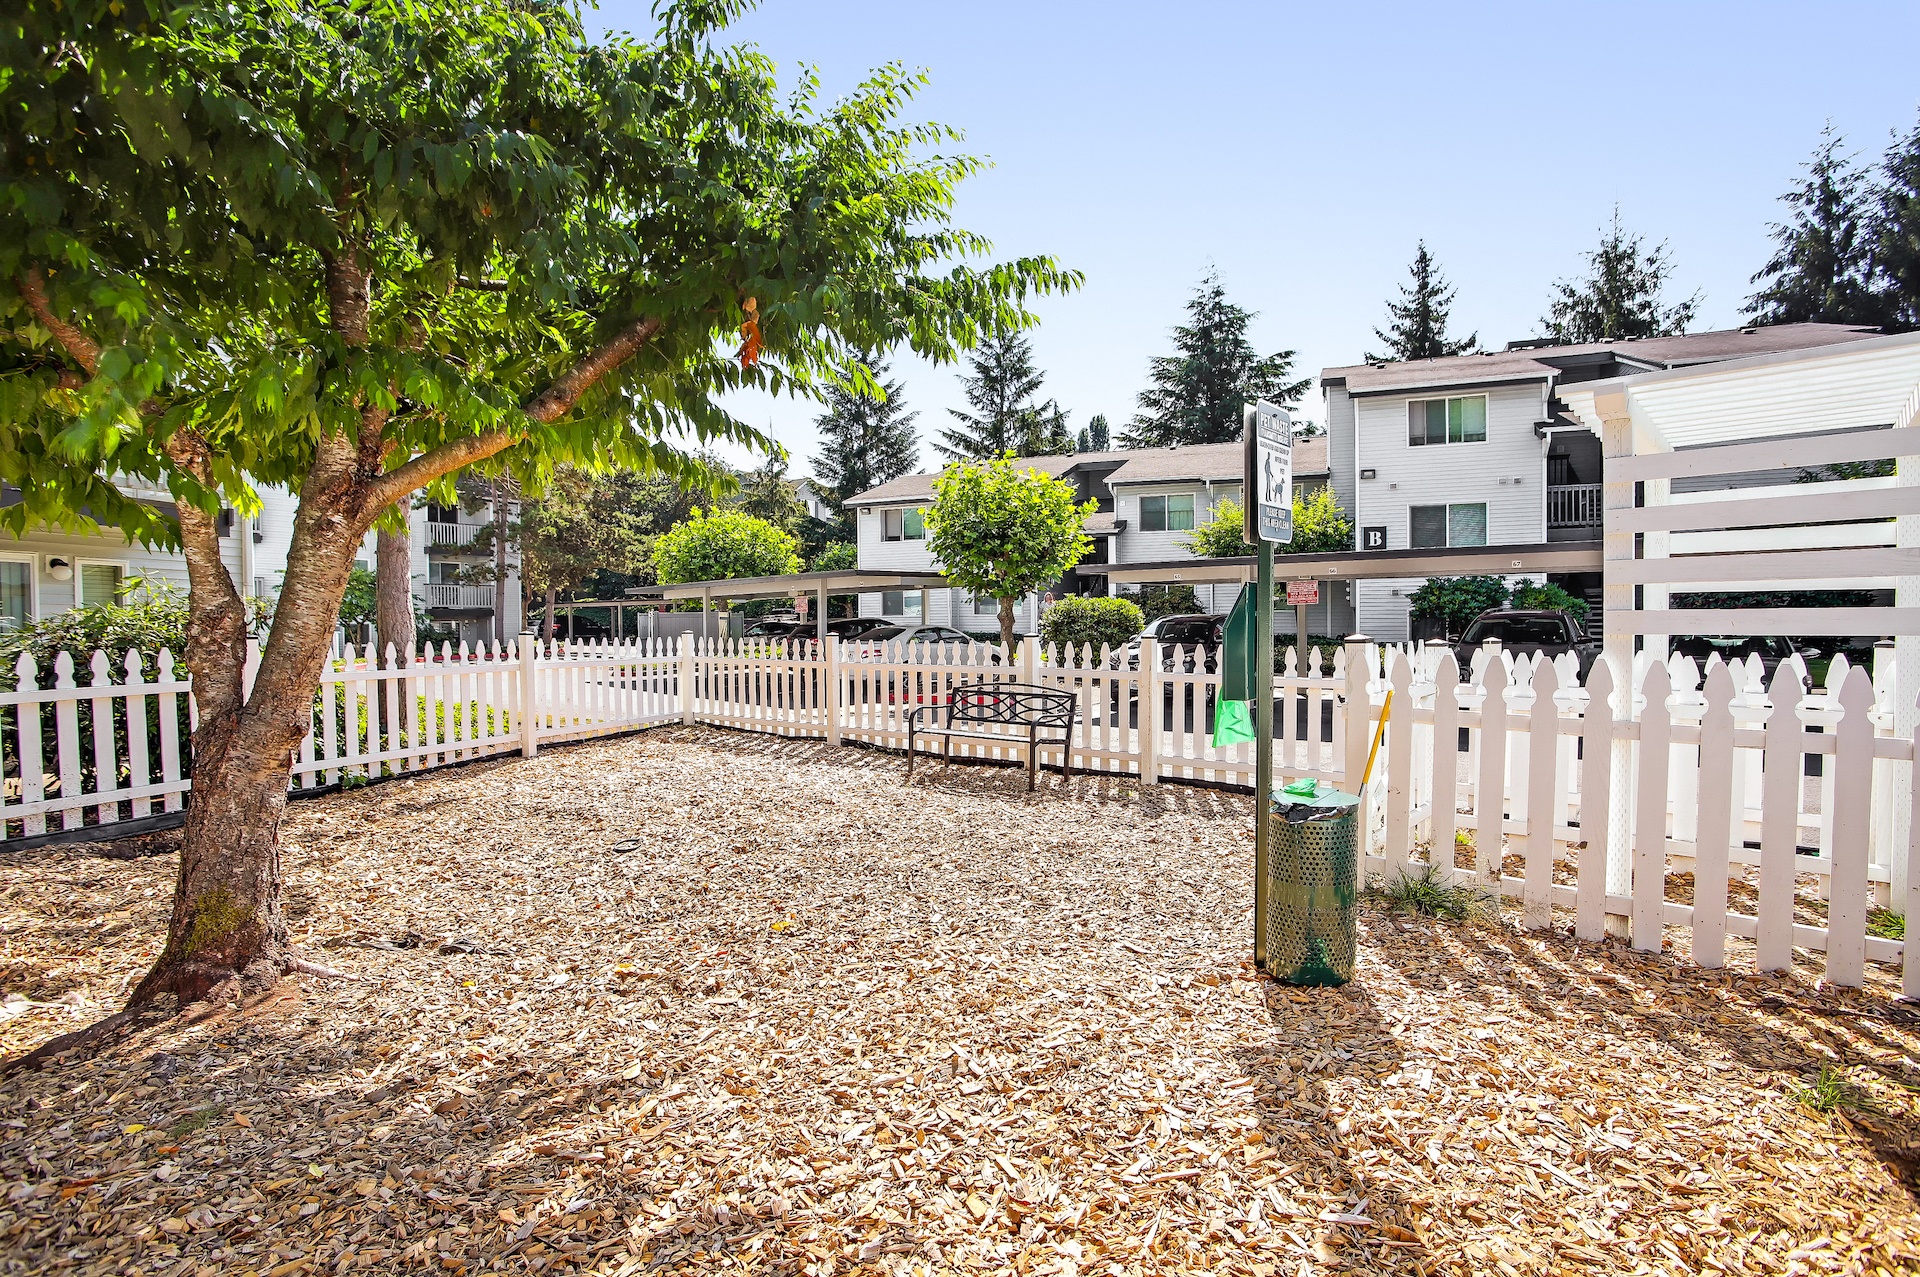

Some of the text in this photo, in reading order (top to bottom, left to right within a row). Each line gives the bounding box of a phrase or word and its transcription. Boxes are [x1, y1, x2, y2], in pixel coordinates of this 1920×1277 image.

[1261, 412, 1288, 435] PET WASTE
[1368, 531, 1382, 547] B
